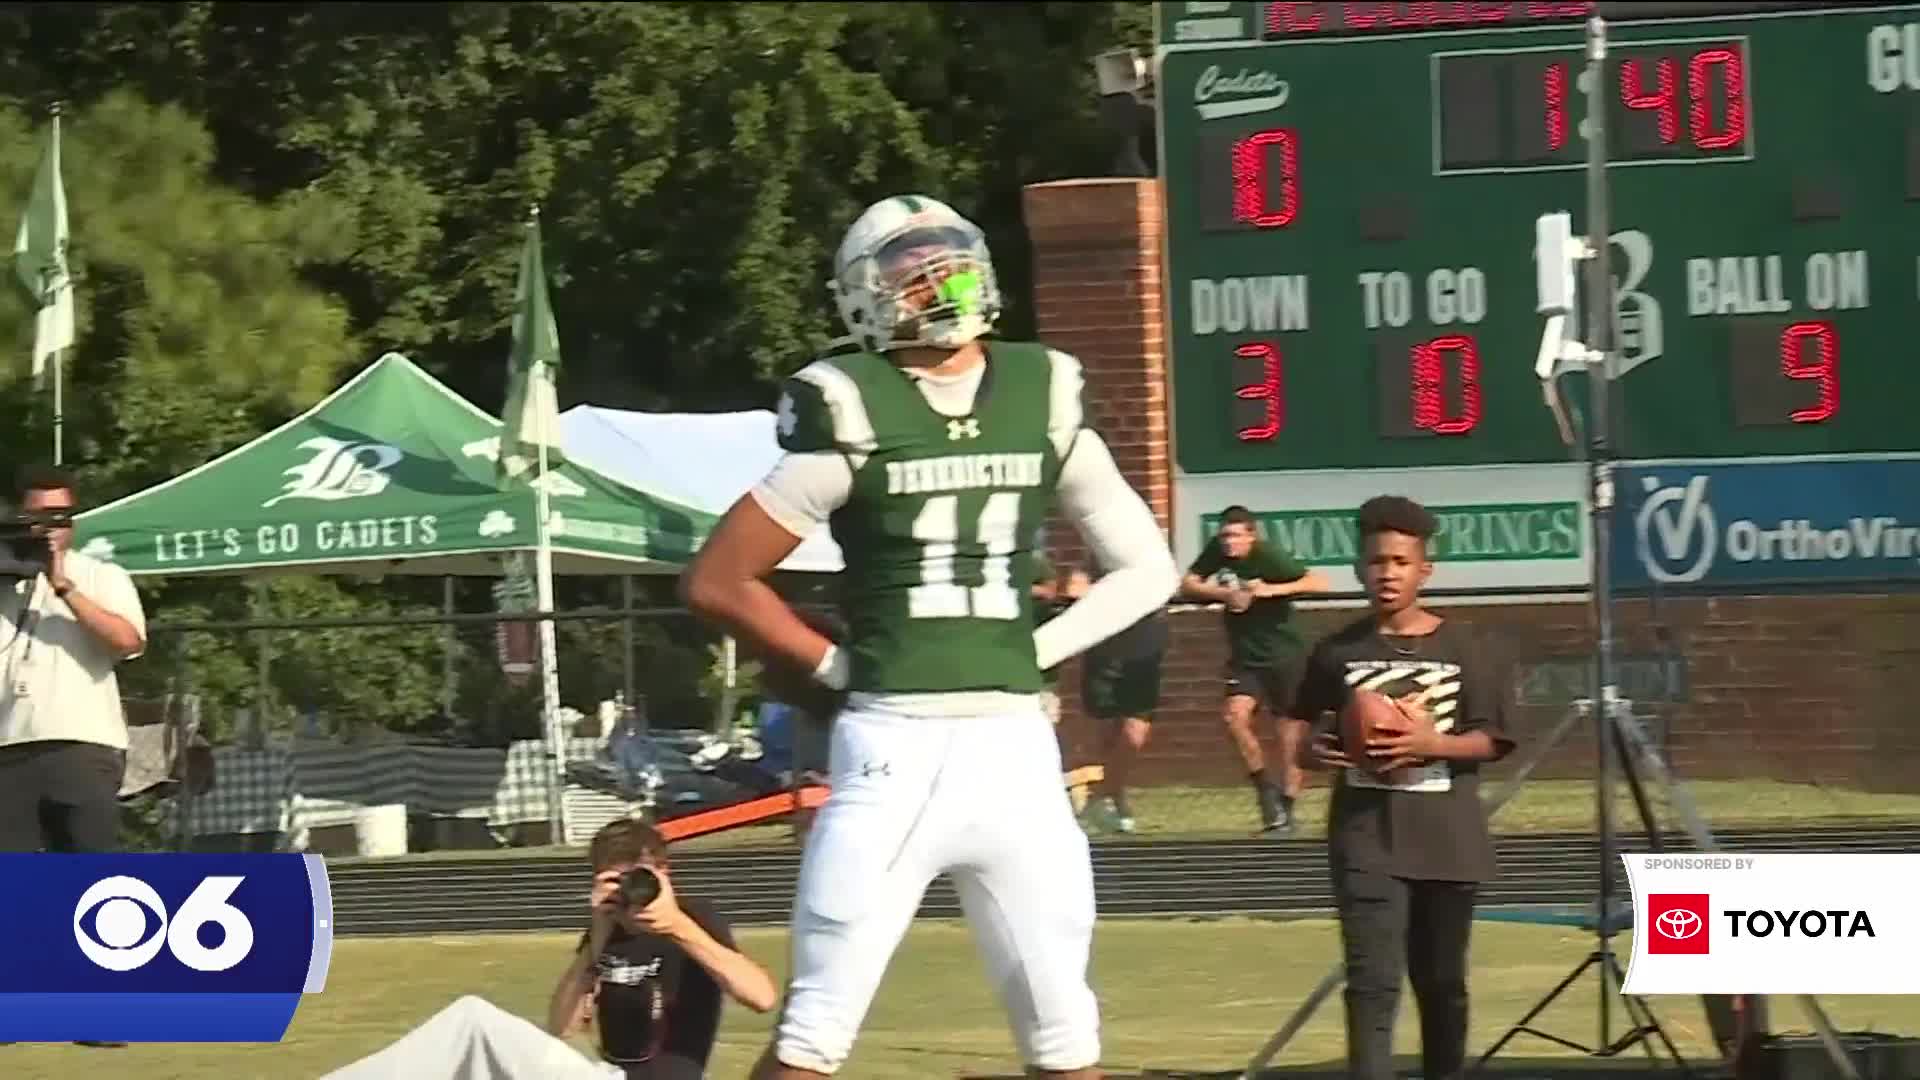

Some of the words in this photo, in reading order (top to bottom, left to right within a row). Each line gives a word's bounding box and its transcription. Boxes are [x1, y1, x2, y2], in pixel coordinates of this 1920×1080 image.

[1190, 274, 1309, 334] DOWN
[1357, 270, 1412, 328] TO
[1426, 266, 1487, 326] GO
[1687, 255, 1792, 316] BALL
[1805, 250, 1868, 311] ON
[1234, 342, 1285, 440] 3
[1780, 322, 1839, 423] 9
[155, 527, 241, 561] LET'S
[257, 522, 299, 554] GO
[316, 515, 437, 550] CADETS
[907, 491, 1023, 621] 11
[1424, 508, 1578, 557] PRINGS
[1726, 517, 1920, 562] OrthoVir
